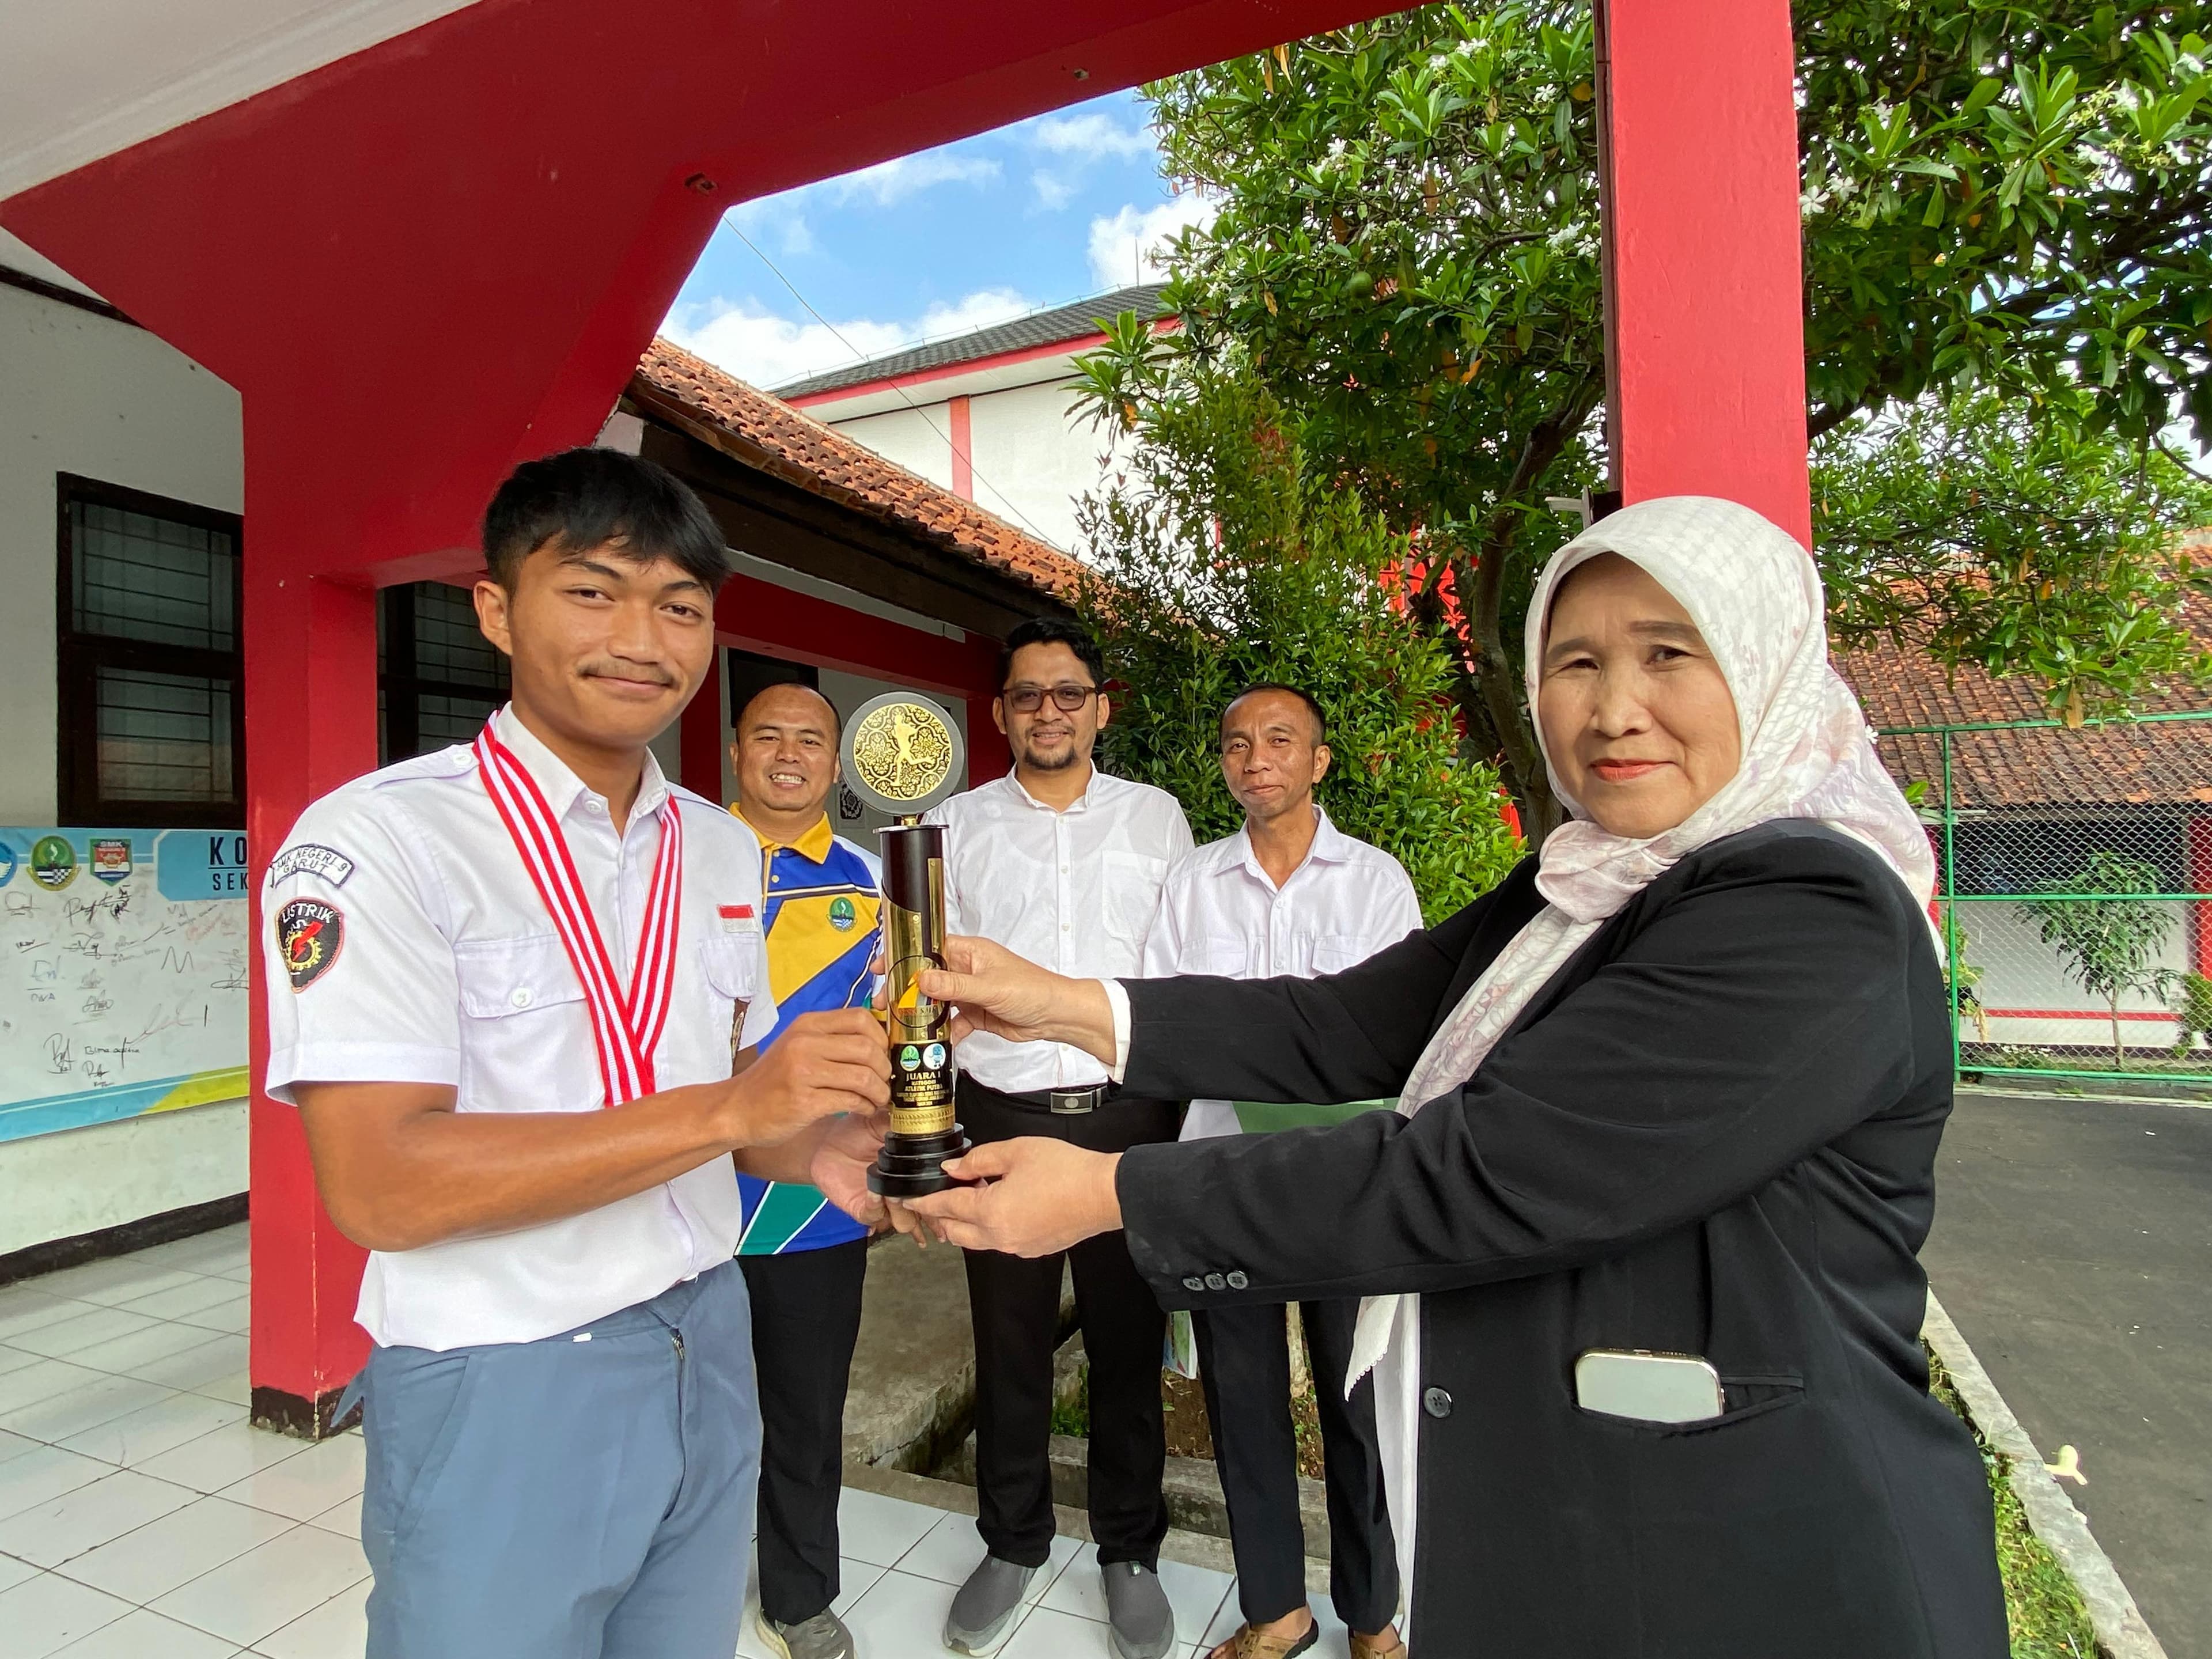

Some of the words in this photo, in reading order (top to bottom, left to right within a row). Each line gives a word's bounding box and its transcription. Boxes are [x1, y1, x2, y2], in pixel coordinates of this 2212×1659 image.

[296, 847, 336, 865] NEGERI
[338, 862, 347, 872] 9
[282, 903, 333, 923] LISTRIK
[906, 1072, 936, 1081] JUARA
